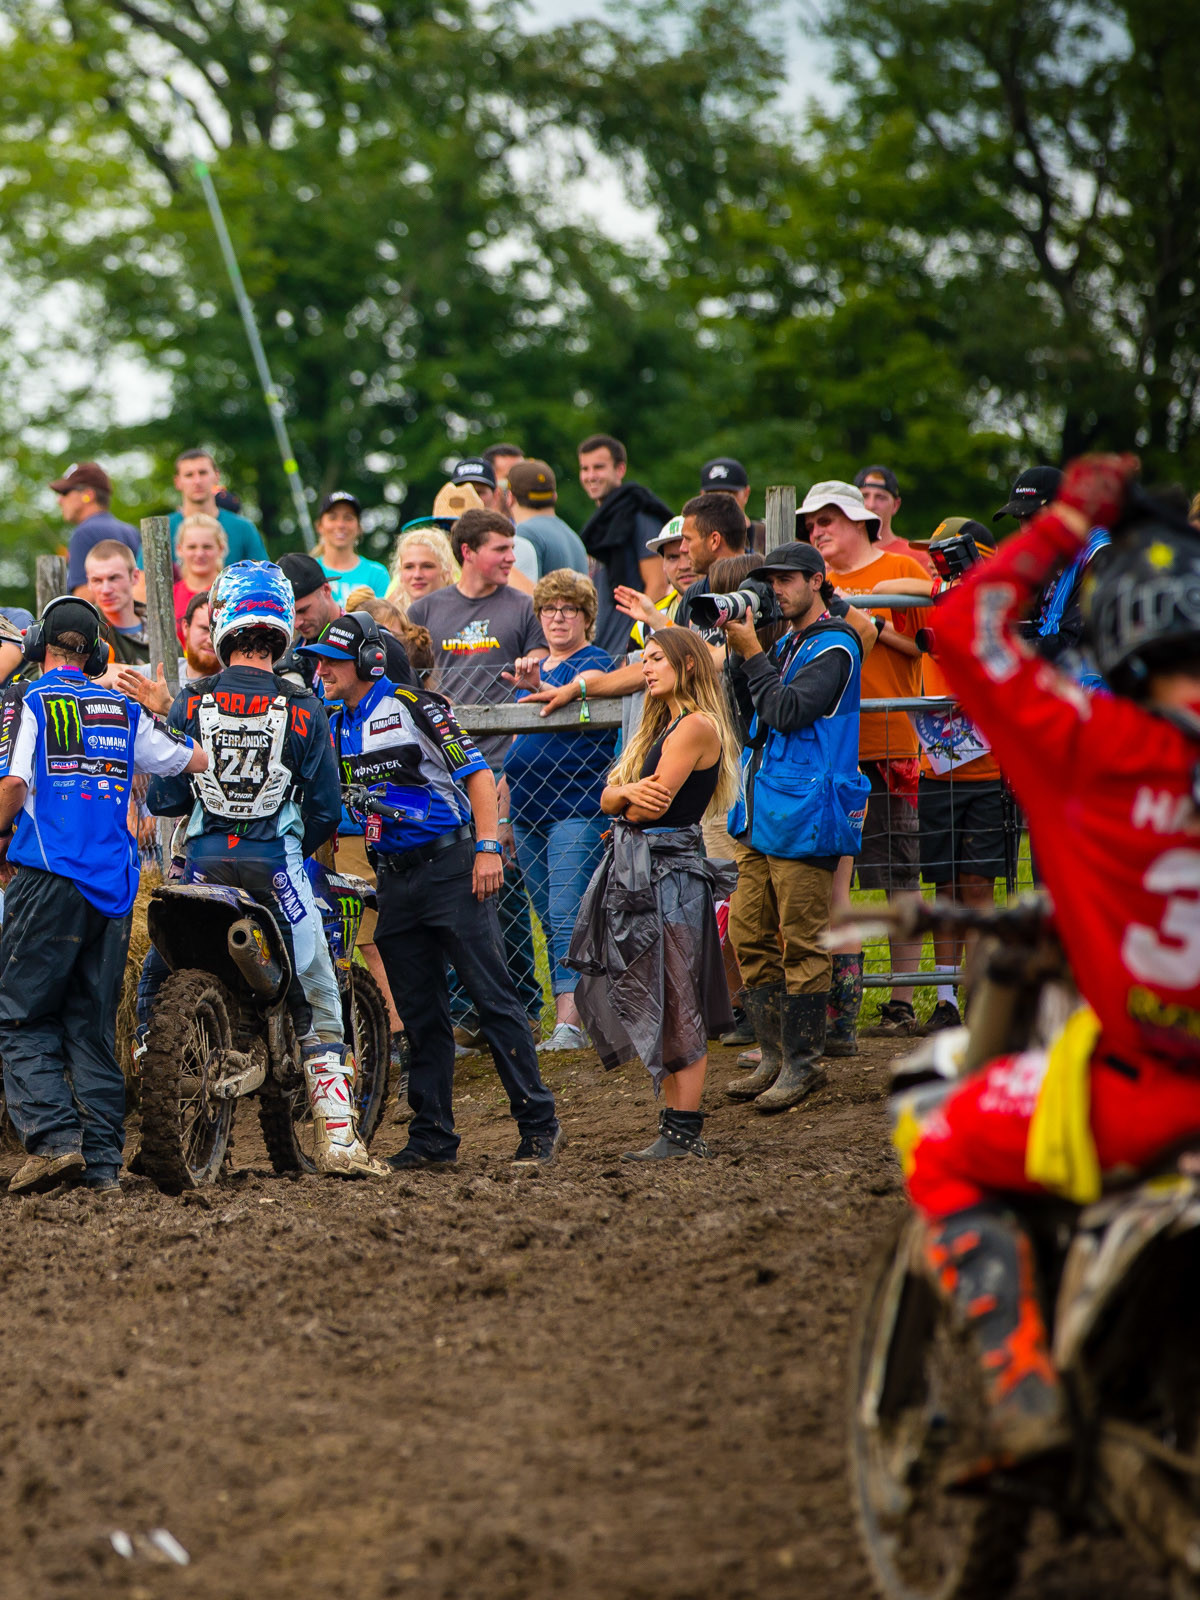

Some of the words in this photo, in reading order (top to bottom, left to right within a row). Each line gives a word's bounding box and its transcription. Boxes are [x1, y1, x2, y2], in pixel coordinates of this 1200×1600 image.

[85, 704, 123, 715] YAMALUBE
[98, 736, 126, 748] YAMAHA
[216, 734, 269, 748] FERRANDIS
[220, 748, 264, 784] 24
[354, 759, 403, 778] MONSTER
